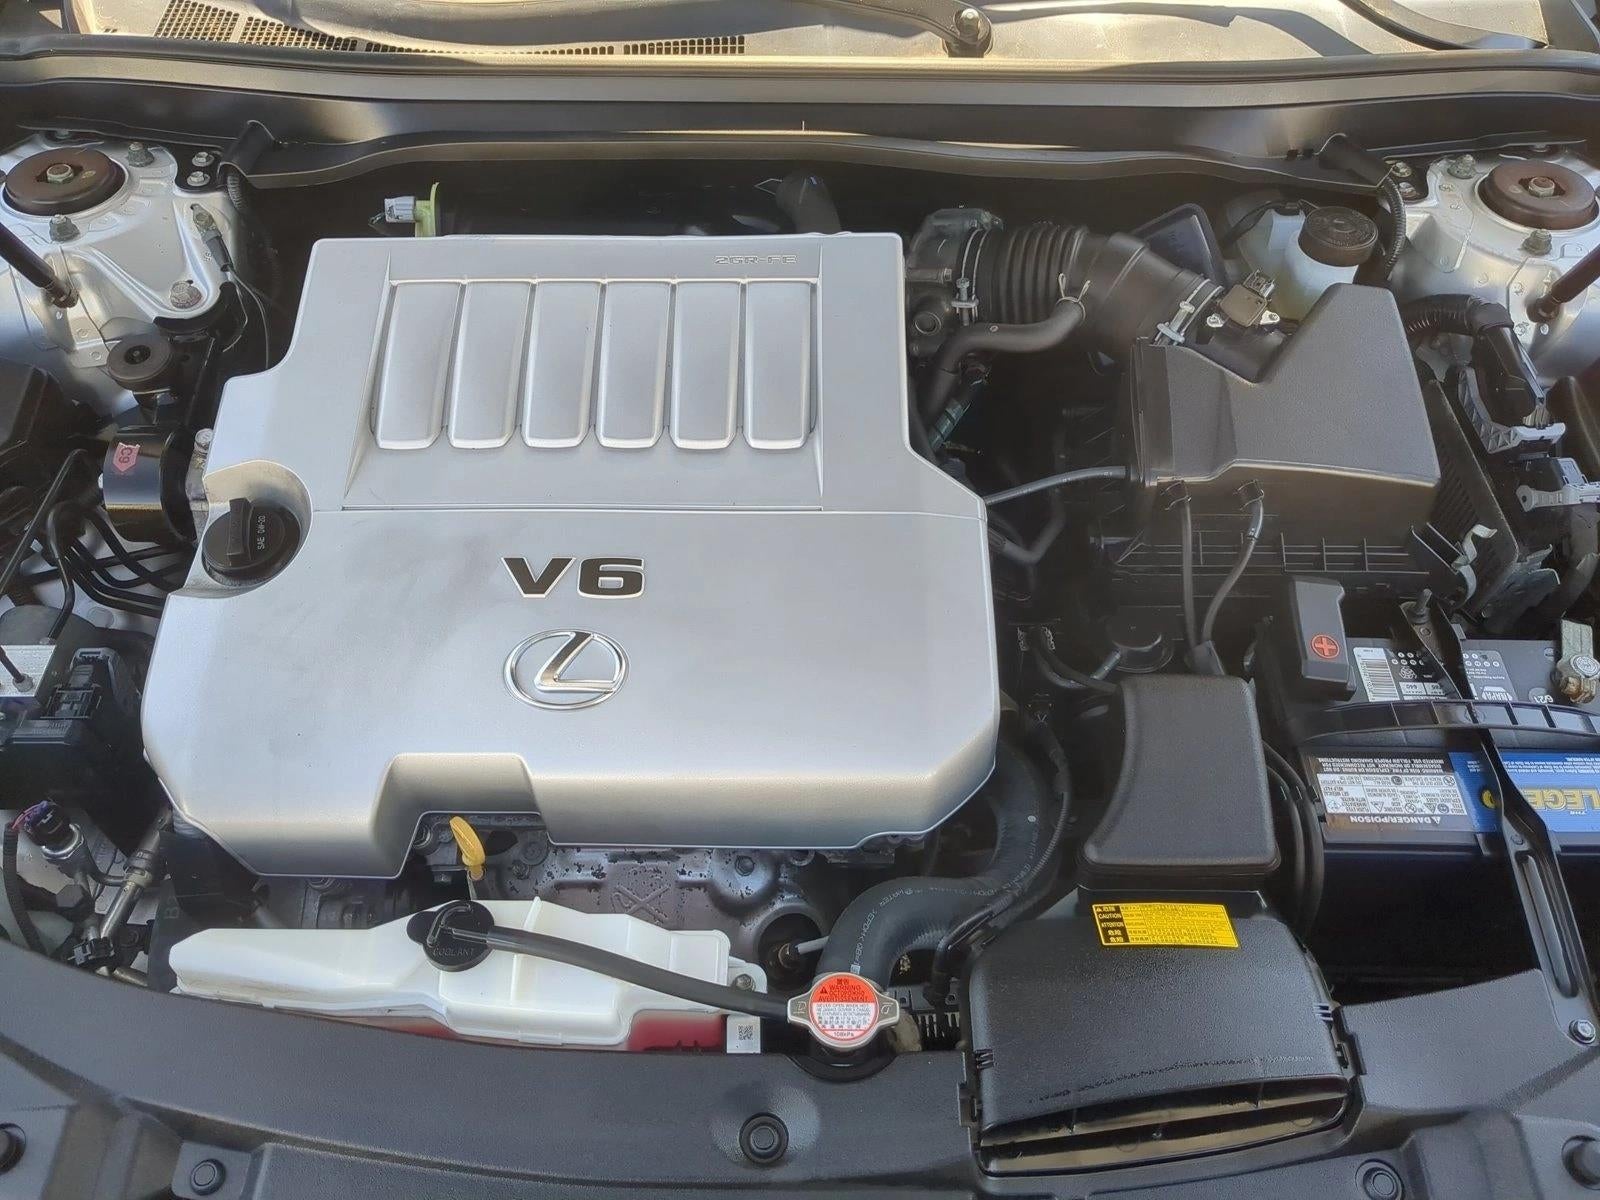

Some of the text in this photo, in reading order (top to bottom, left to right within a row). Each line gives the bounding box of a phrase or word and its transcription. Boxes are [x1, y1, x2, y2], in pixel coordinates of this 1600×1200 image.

[257, 515, 266, 550] SAE 0W-20
[501, 556, 645, 599] V6
[1350, 815, 1431, 824] DANGER/POISON
[433, 947, 474, 957] COOLANT
